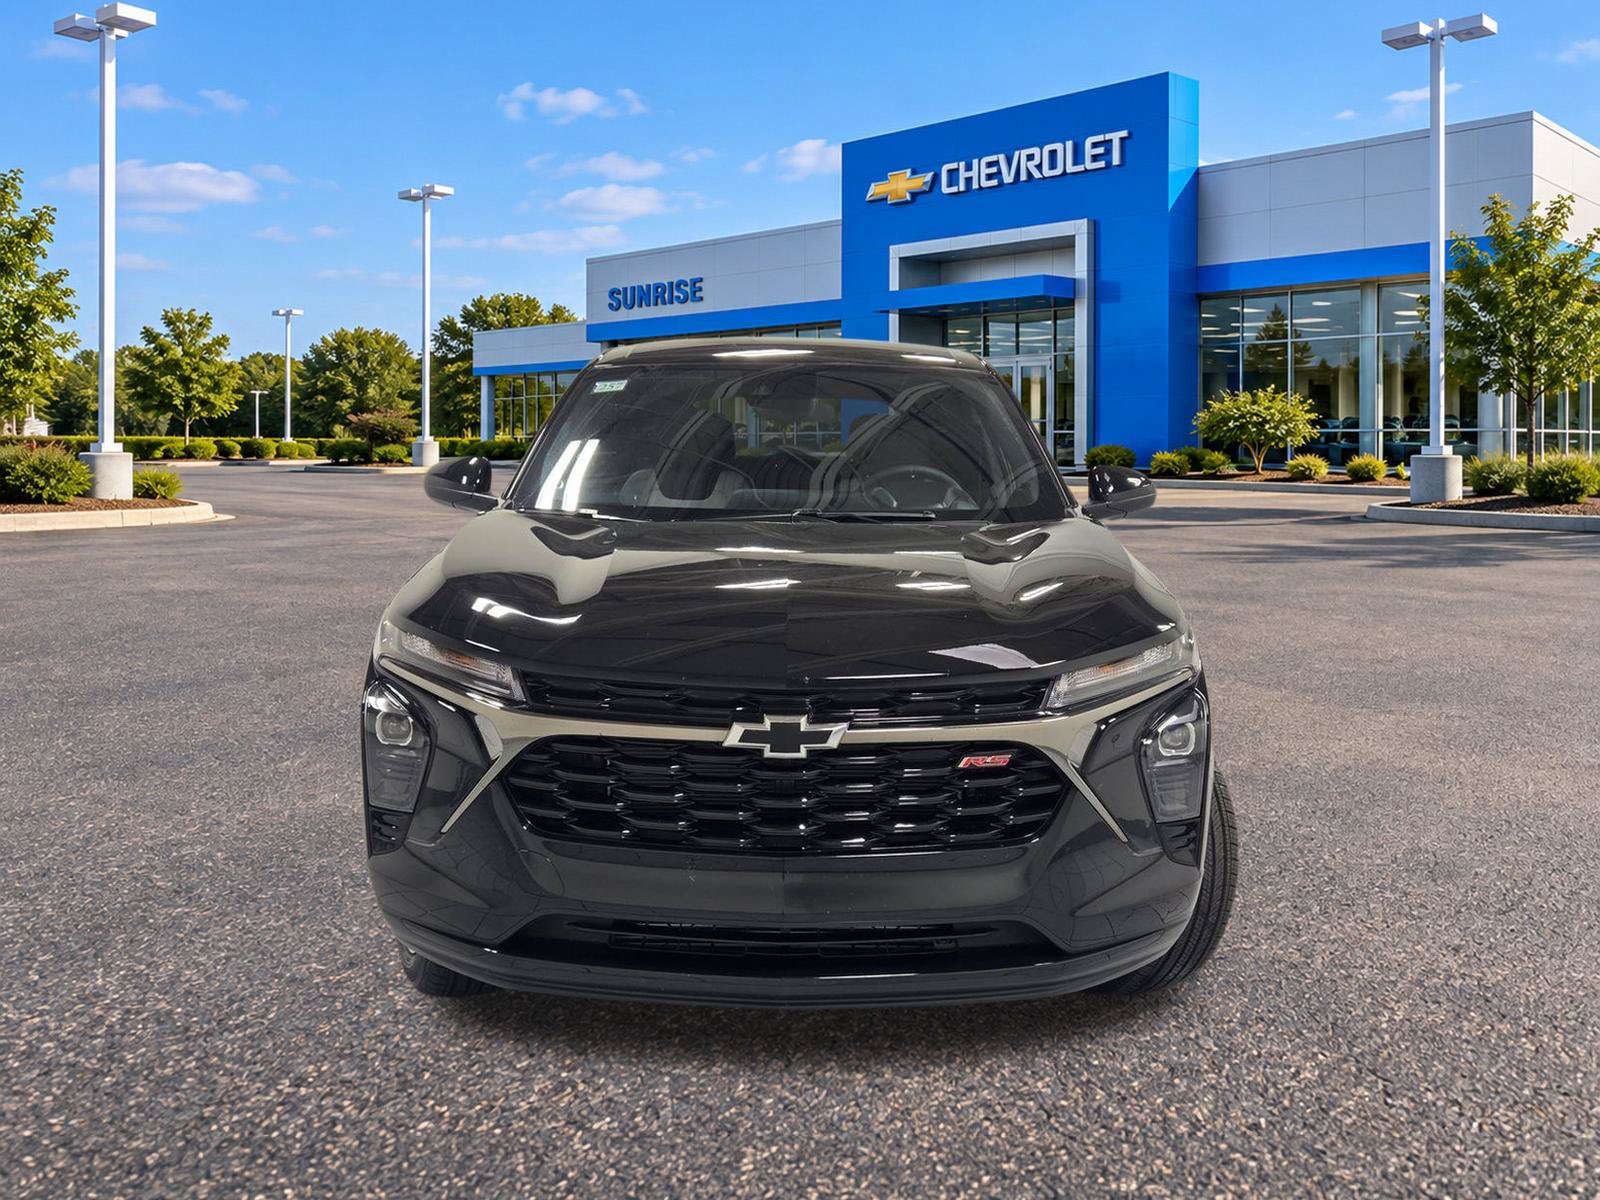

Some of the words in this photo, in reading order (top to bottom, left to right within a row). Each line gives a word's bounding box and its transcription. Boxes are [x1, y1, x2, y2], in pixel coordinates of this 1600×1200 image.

[941, 130, 1129, 194] CHEVROLET
[608, 277, 704, 312] SUNRISE
[959, 755, 1011, 768] RS
